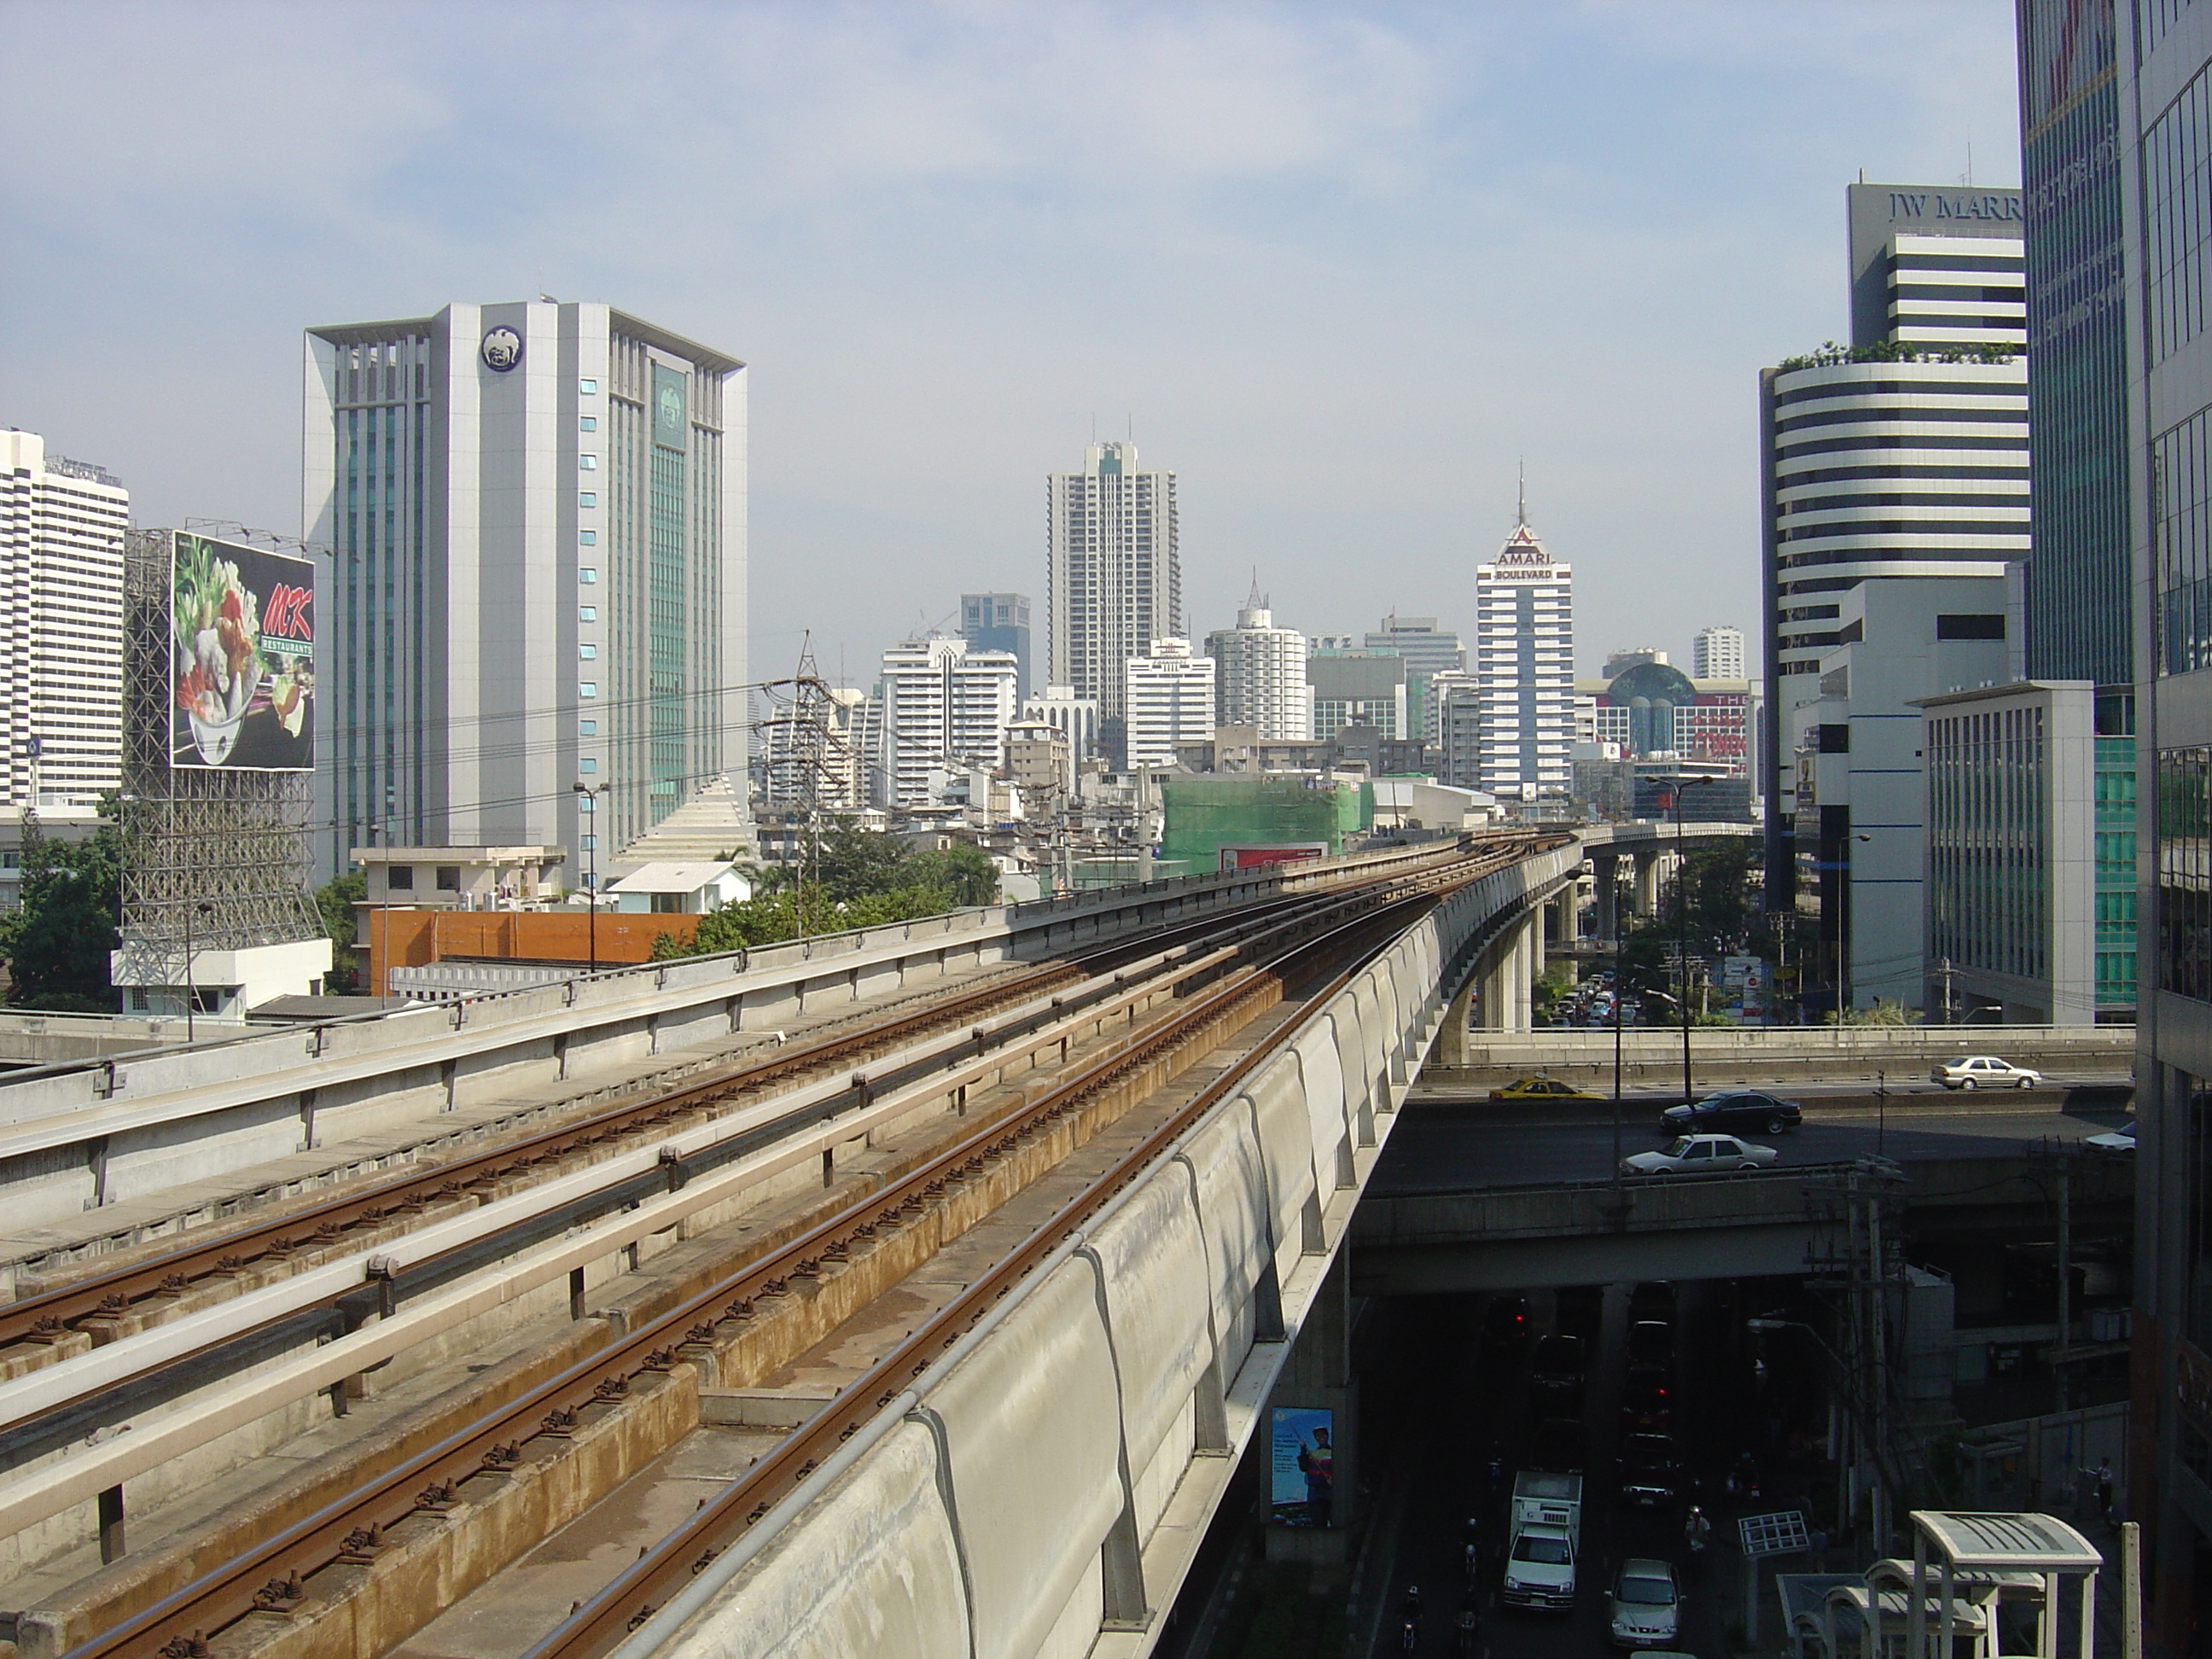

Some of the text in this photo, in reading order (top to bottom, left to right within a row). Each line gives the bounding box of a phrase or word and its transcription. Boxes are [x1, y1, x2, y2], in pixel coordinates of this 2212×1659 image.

[1889, 192, 1929, 223] JW
[1498, 554, 1551, 565] AMARI
[1496, 570, 1551, 579] BOULEVARD
[264, 582, 312, 641] MK
[263, 640, 312, 655] RESTAURANTS
